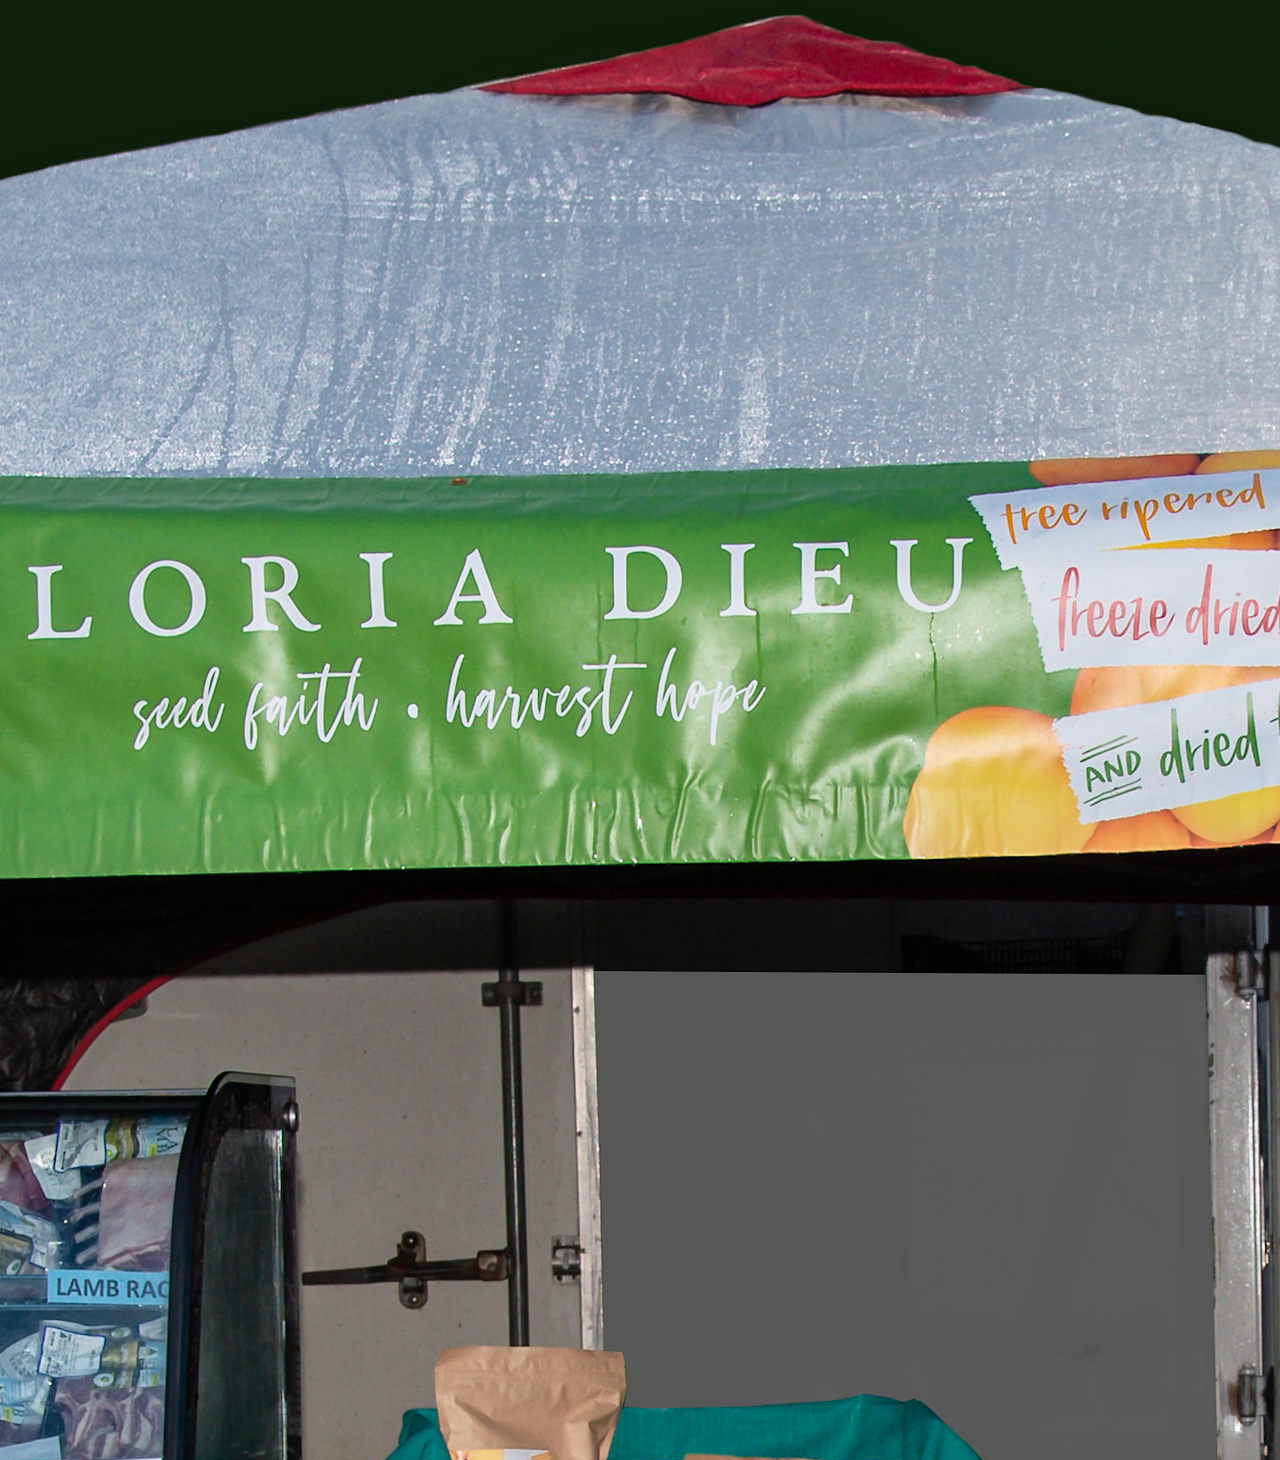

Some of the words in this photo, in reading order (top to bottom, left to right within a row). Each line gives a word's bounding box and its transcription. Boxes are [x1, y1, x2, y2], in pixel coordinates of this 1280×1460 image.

[1001, 503, 1088, 544] tree
[1102, 472, 1266, 541] ripened
[604, 537, 973, 621] DIEU
[1054, 566, 1175, 652] freeze
[132, 666, 221, 750] seed
[243, 657, 380, 752] faith
[445, 653, 648, 737] harvest
[656, 647, 766, 747] hope
[1085, 750, 1141, 792] AND
[1159, 691, 1261, 784] dried
[56, 1277, 119, 1298] LAMB
